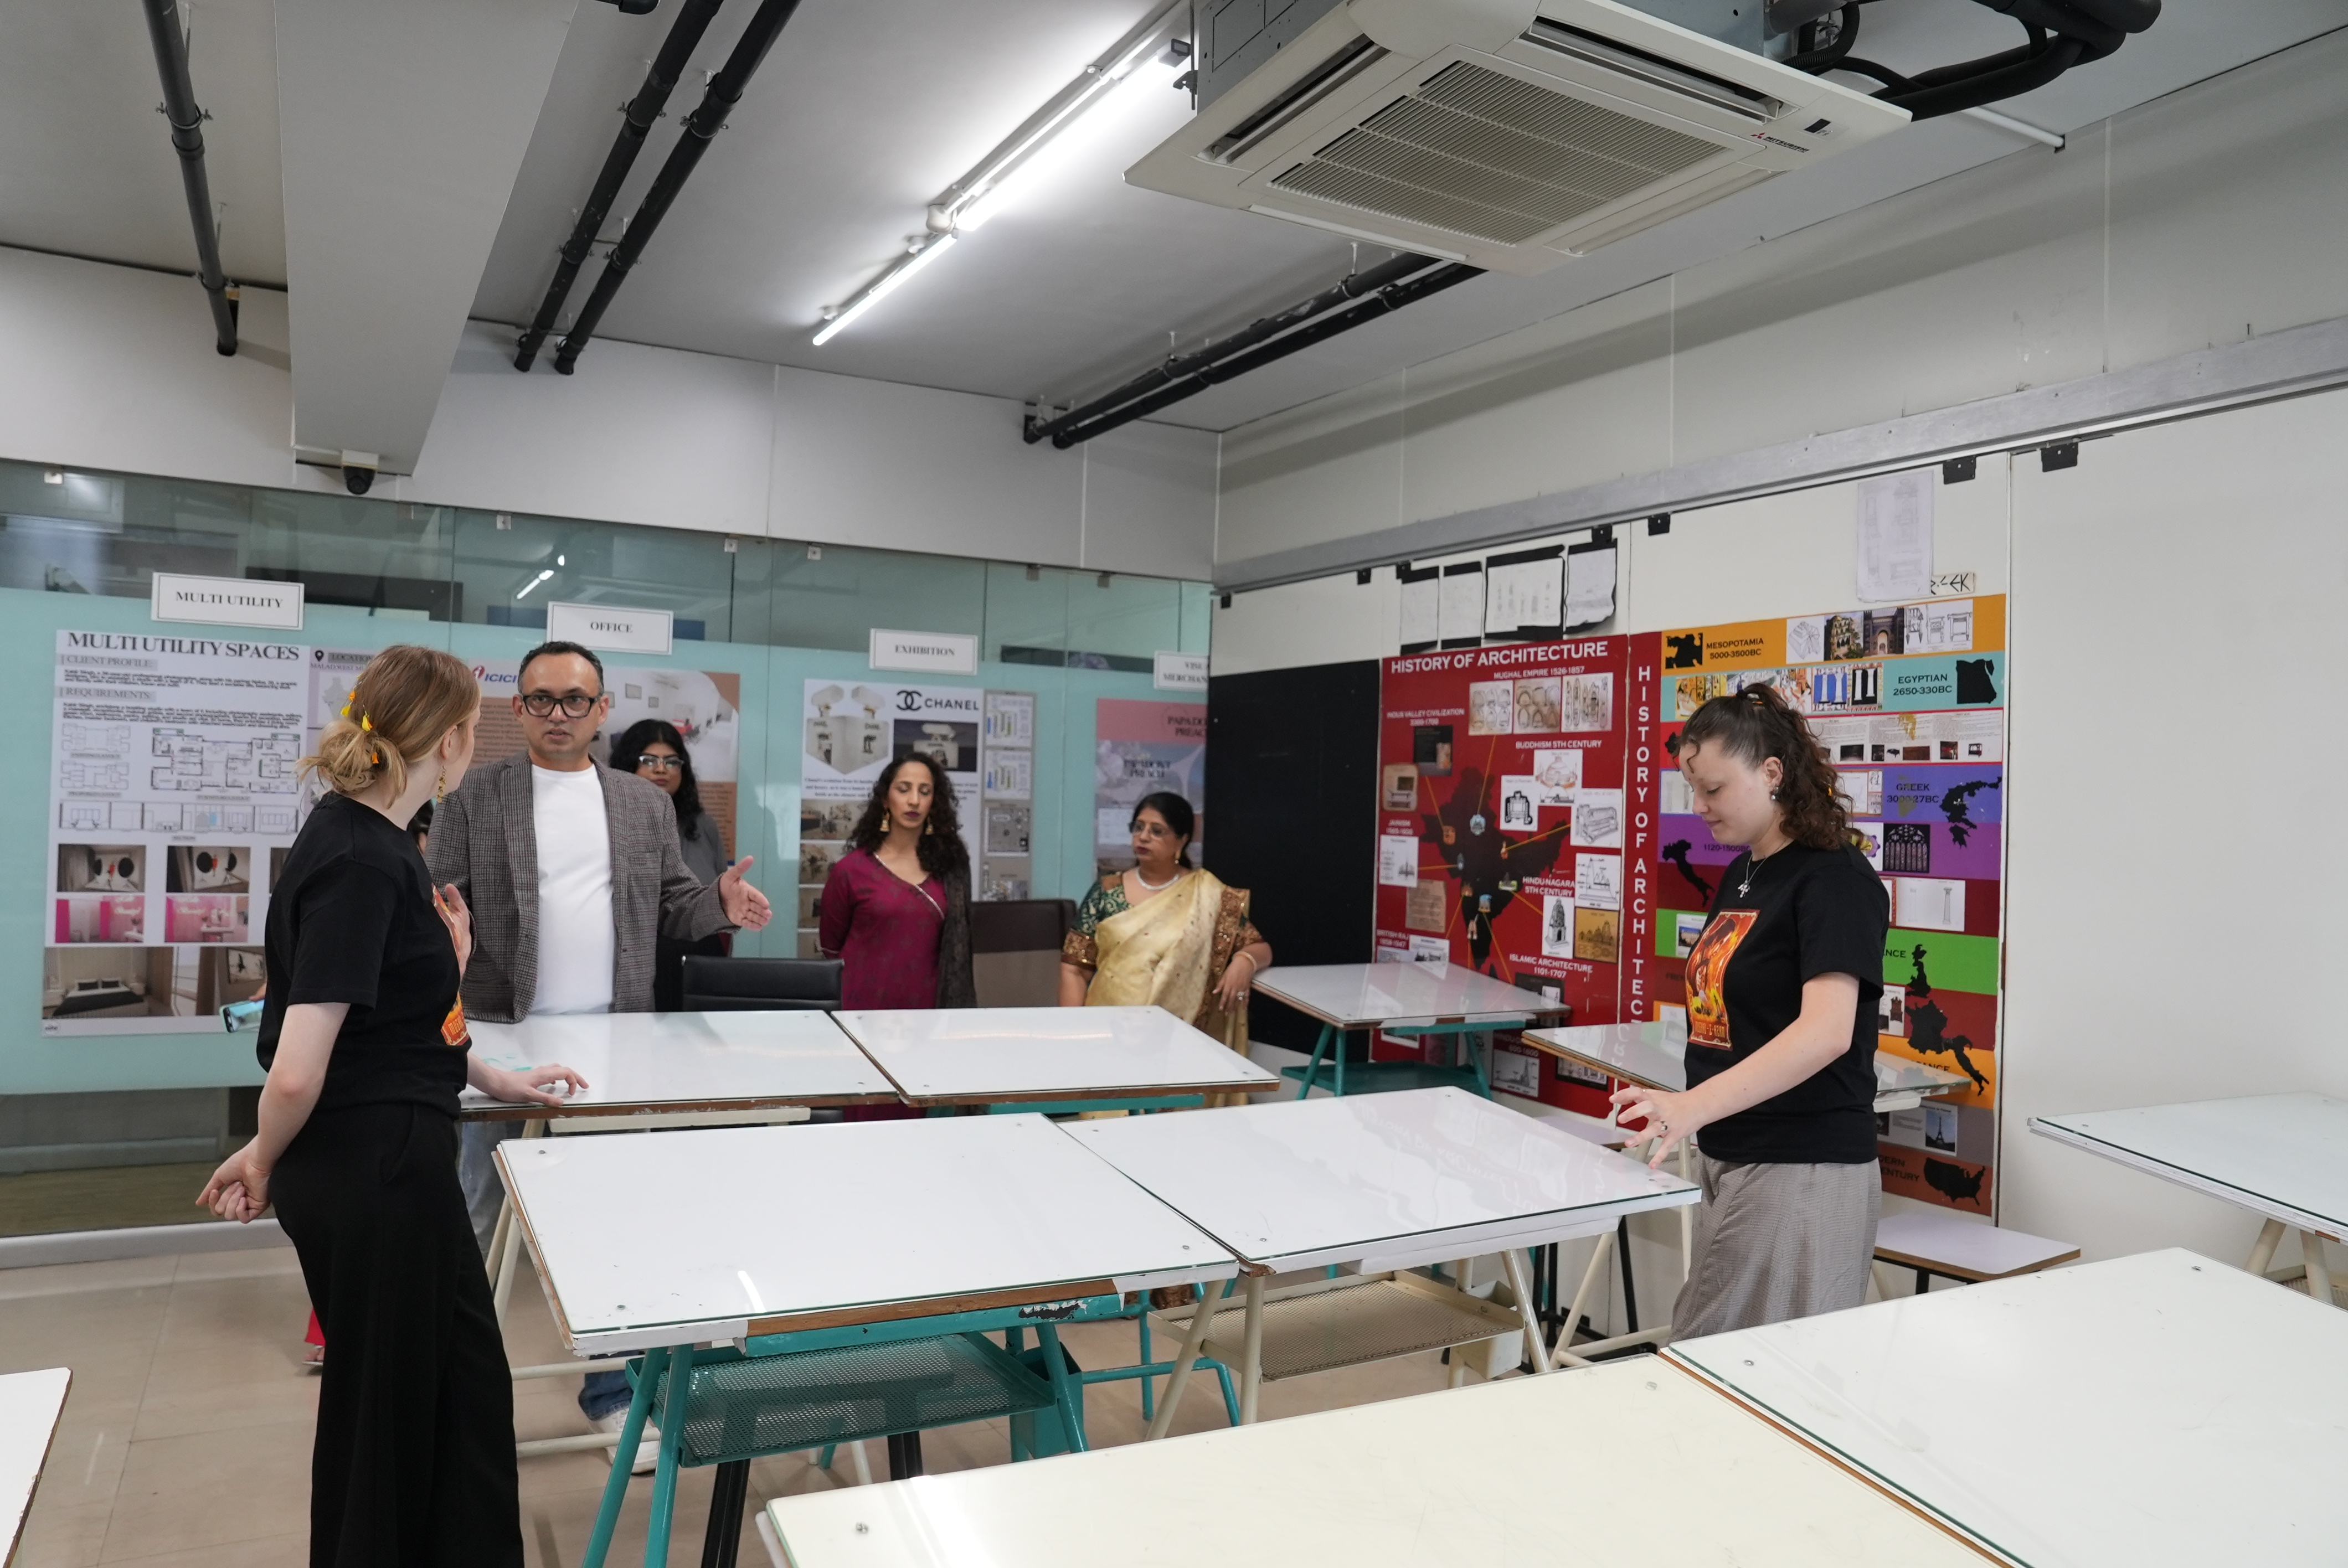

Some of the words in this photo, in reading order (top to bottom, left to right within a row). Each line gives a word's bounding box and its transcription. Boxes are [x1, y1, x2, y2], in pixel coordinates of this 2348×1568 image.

[1764, 136, 1810, 152] MITSUBISHI
[176, 591, 221, 604] MULTI
[228, 596, 283, 608] UTILITY
[590, 621, 633, 633] OFFICE
[68, 632, 137, 651] MULTI
[143, 637, 222, 656] UTILITY
[225, 643, 300, 661] SPACES
[1706, 638, 1764, 649] MESOPOTAMIA
[895, 644, 955, 656] EXHIBITION
[1709, 648, 1762, 659] 5000-3500BC
[67, 655, 104, 664] CLIENT
[1391, 656, 1450, 674] HISTORY
[1454, 653, 1475, 668] OF
[1477, 641, 1608, 666] ARCHITECTURE
[485, 674, 517, 683] ICICI
[1494, 670, 1522, 680] MUGHAL
[1523, 668, 1548, 678] EMPIRE
[1898, 674, 1948, 684] EGYPTIAN
[1893, 685, 1952, 696] 2650-330BC
[924, 698, 980, 711] CHANEL
[1636, 666, 1650, 802] HISTORY
[1516, 741, 1551, 749] BUDDHISM
[1567, 740, 1602, 748] CENTURY
[1635, 812, 1648, 848] OF
[1539, 888, 1573, 897] CENTURY
[1630, 858, 1647, 1023] ARCHITEC
[1510, 953, 1537, 964] ISLAMIC
[1538, 958, 1593, 973] ARCHITECTURE
